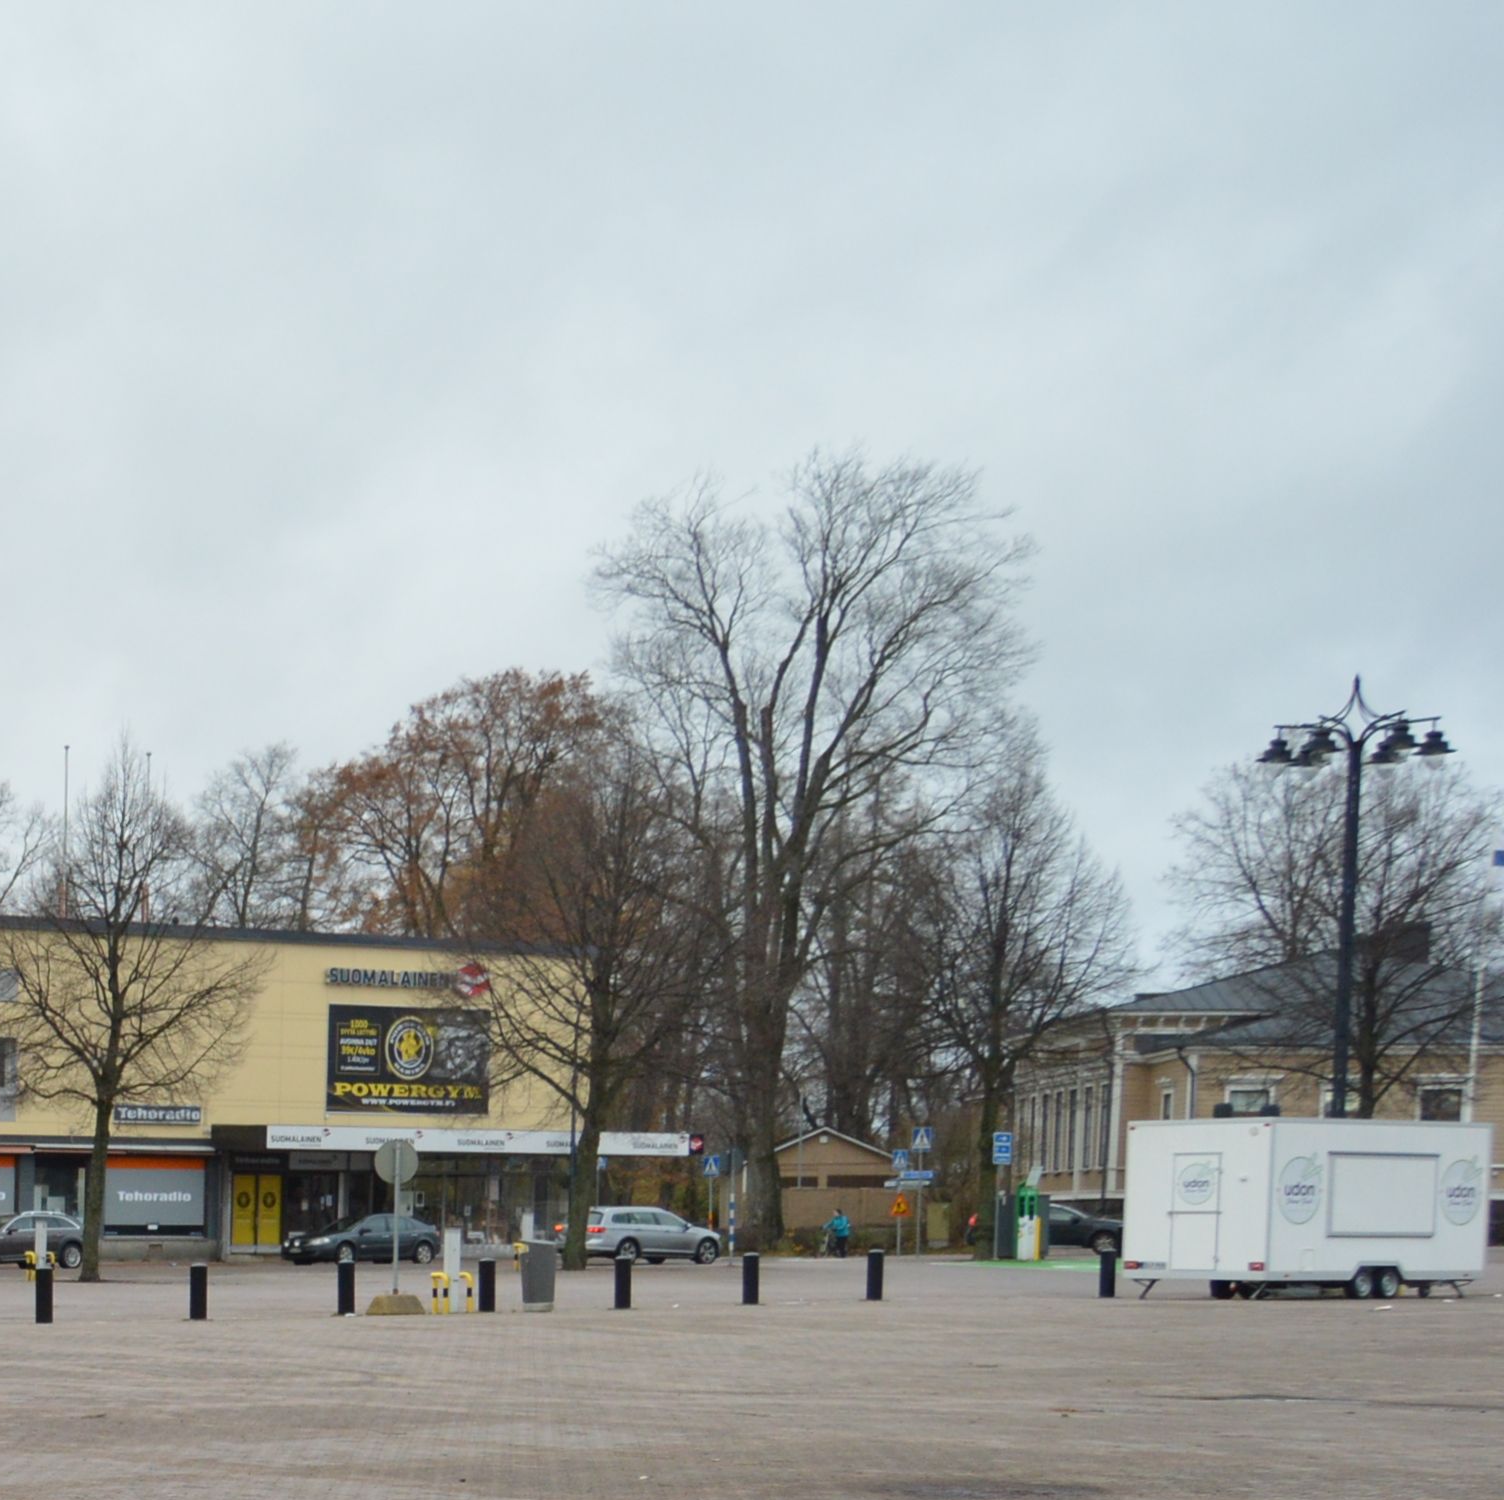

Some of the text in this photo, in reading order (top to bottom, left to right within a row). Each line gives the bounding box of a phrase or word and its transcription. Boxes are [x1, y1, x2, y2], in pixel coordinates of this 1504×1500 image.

[329, 967, 452, 988] SUOMALAINEN
[334, 1082, 482, 1099] POWERGYM
[117, 1107, 201, 1120] Tehoradio
[271, 1135, 322, 1143] SUOMALAINEN
[457, 1139, 505, 1147] SUOMALAINEN
[1183, 1179, 1209, 1188] udon
[1284, 1182, 1315, 1196] udon
[117, 1190, 191, 1202] Tehoradio
[1446, 1184, 1476, 1198] udon
